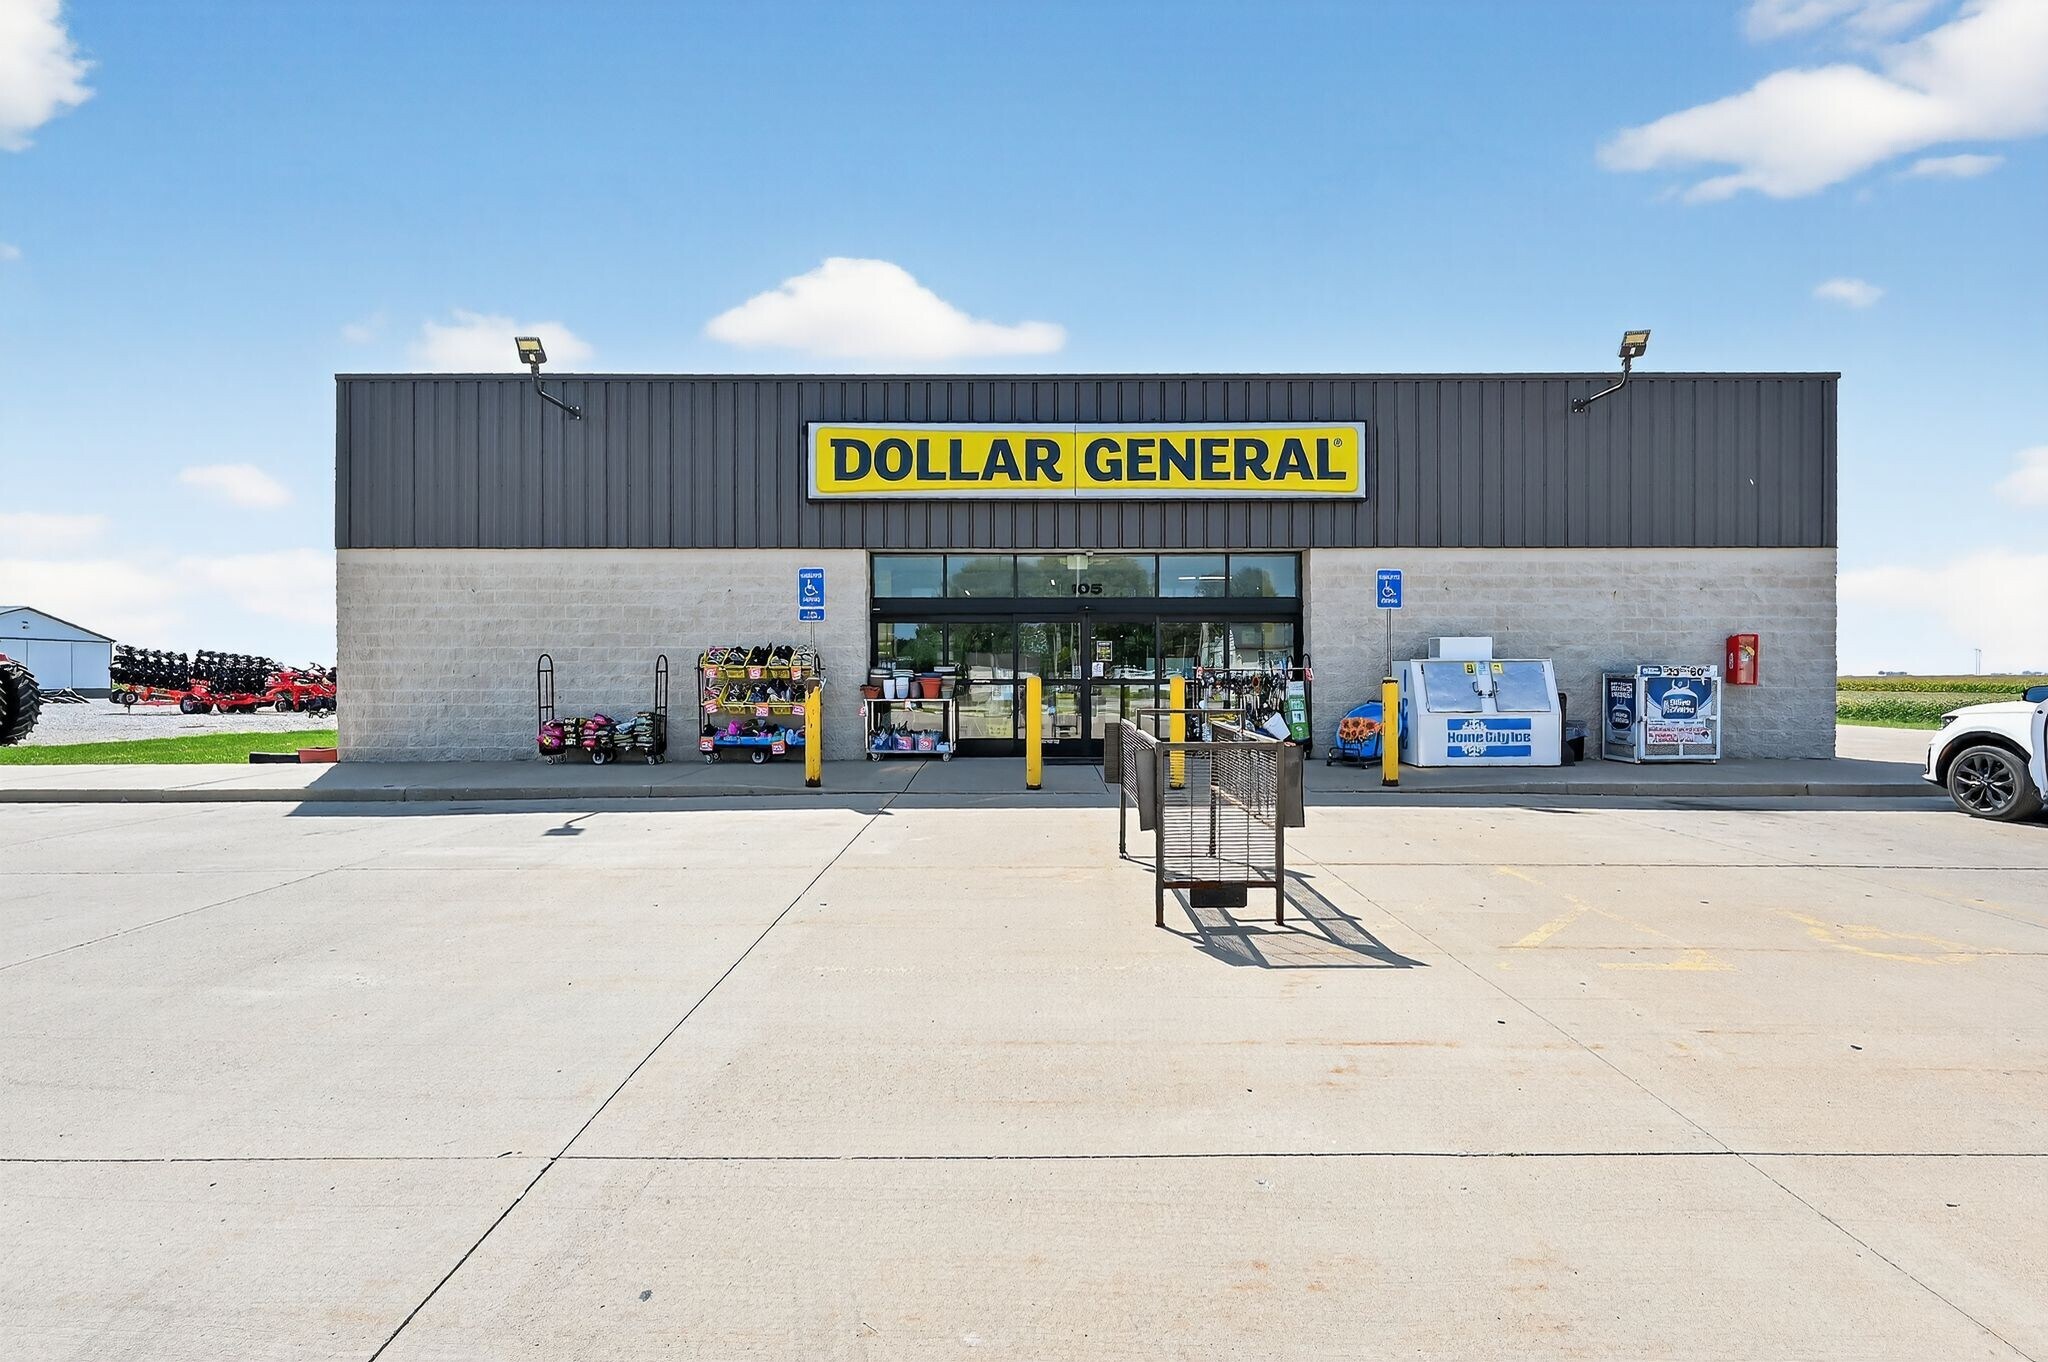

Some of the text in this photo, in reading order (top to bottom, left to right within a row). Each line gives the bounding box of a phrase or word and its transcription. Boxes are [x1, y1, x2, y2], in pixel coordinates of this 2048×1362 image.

[831, 438, 1347, 481] DOLLAR GENERAL
[1447, 732, 1484, 743] Home
